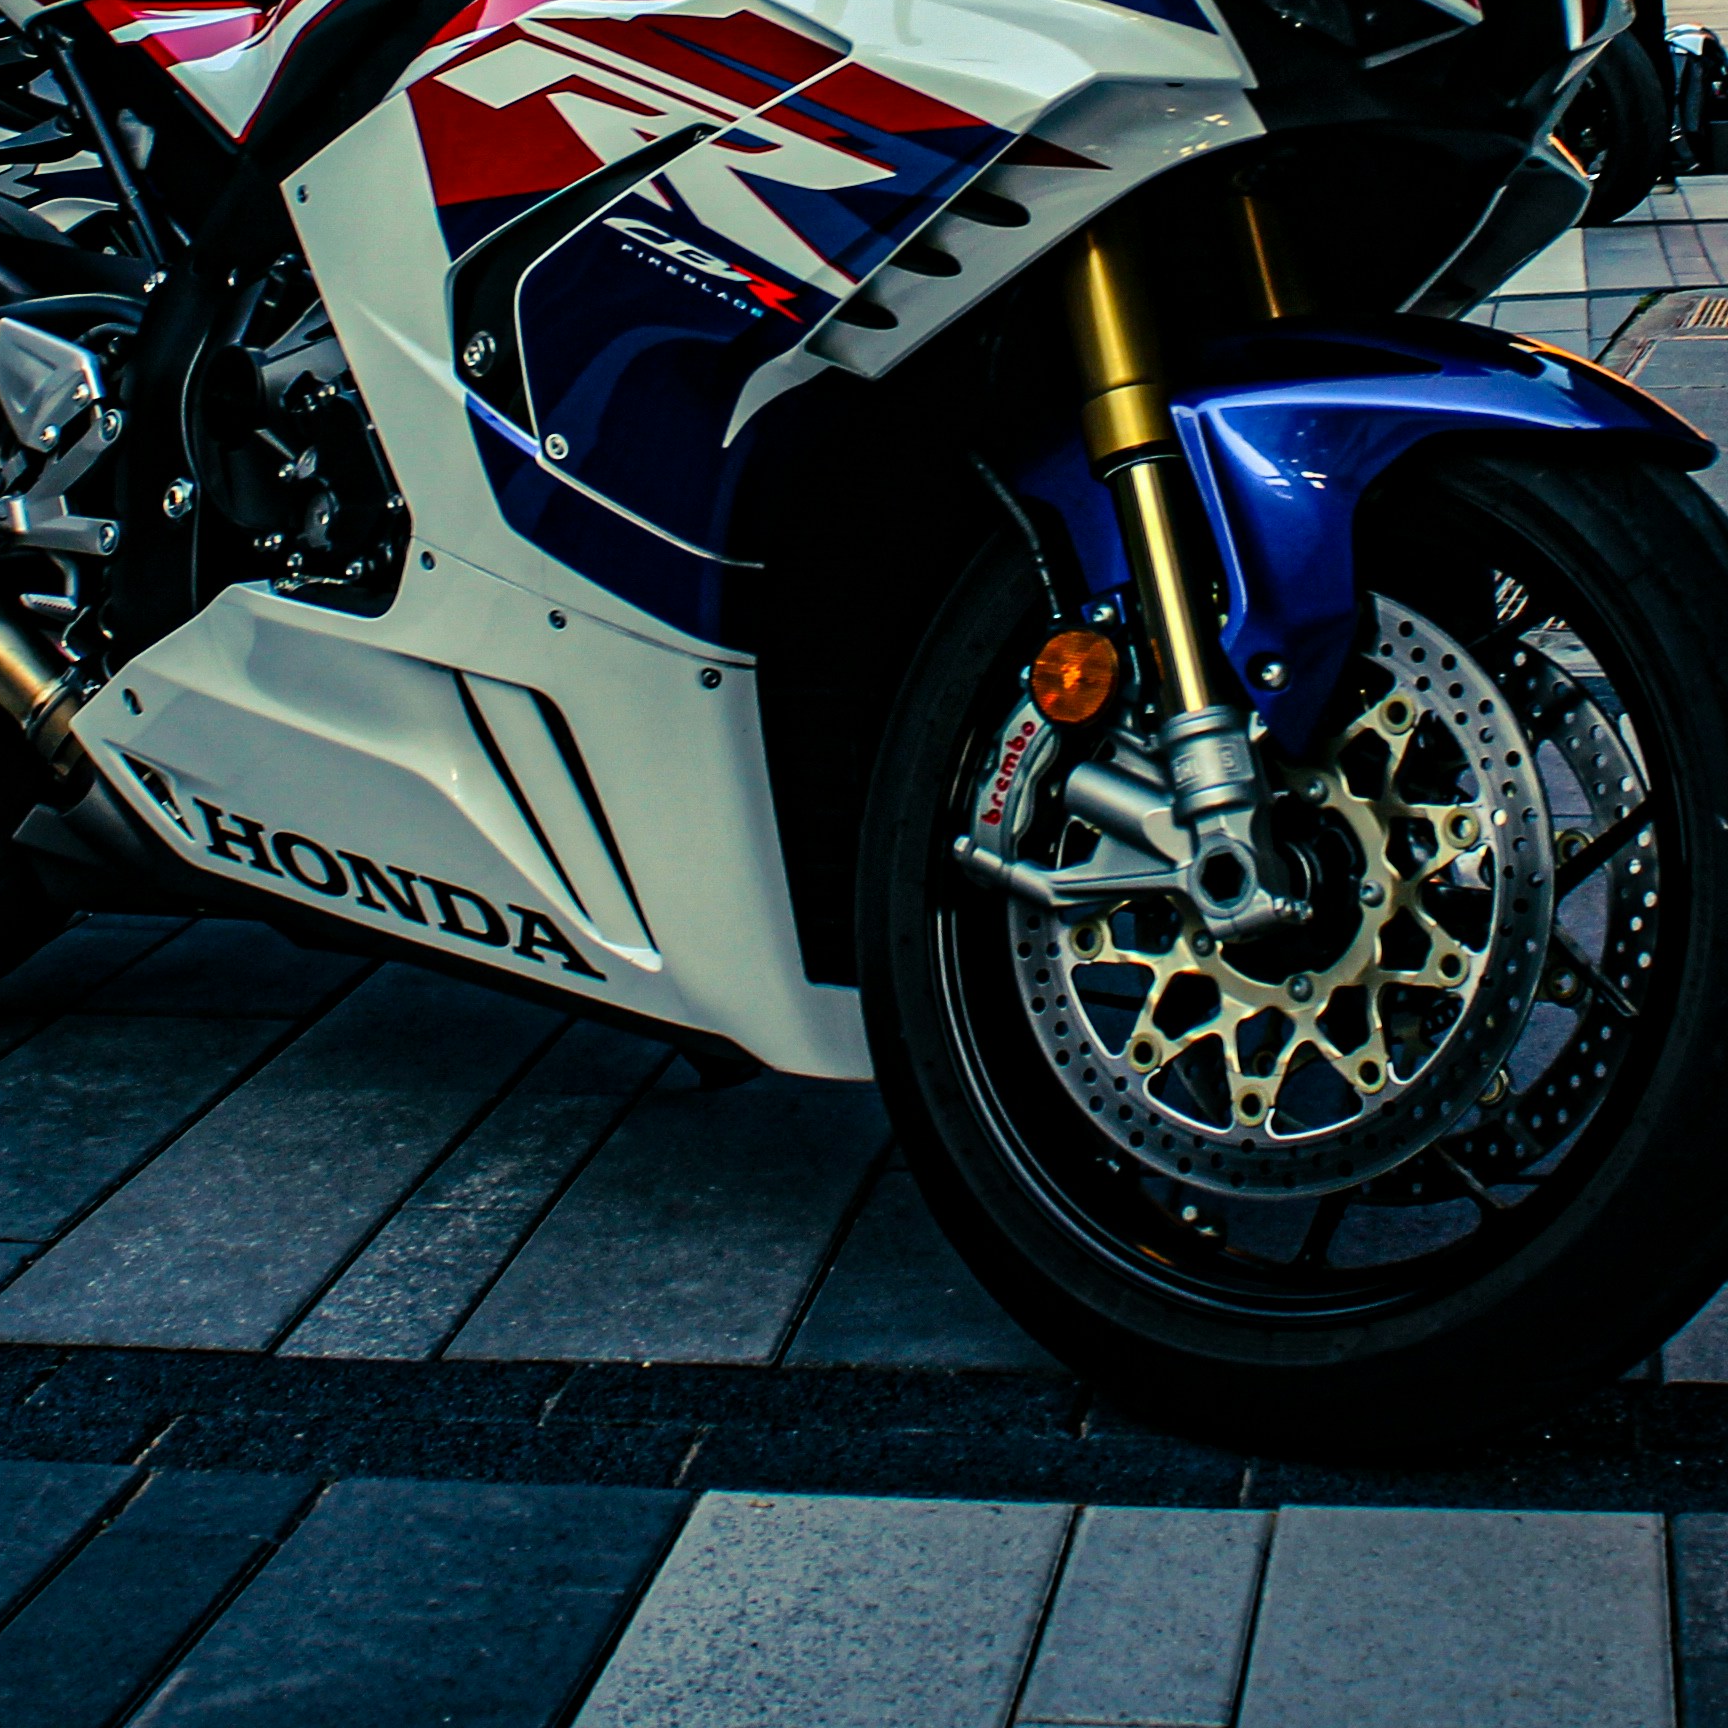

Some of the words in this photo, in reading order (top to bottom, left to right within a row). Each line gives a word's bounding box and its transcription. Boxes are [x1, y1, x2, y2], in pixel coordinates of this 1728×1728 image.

[621, 243, 765, 318] FIREBLADE
[980, 721, 1036, 826] brembo
[192, 796, 608, 983] HONDA
